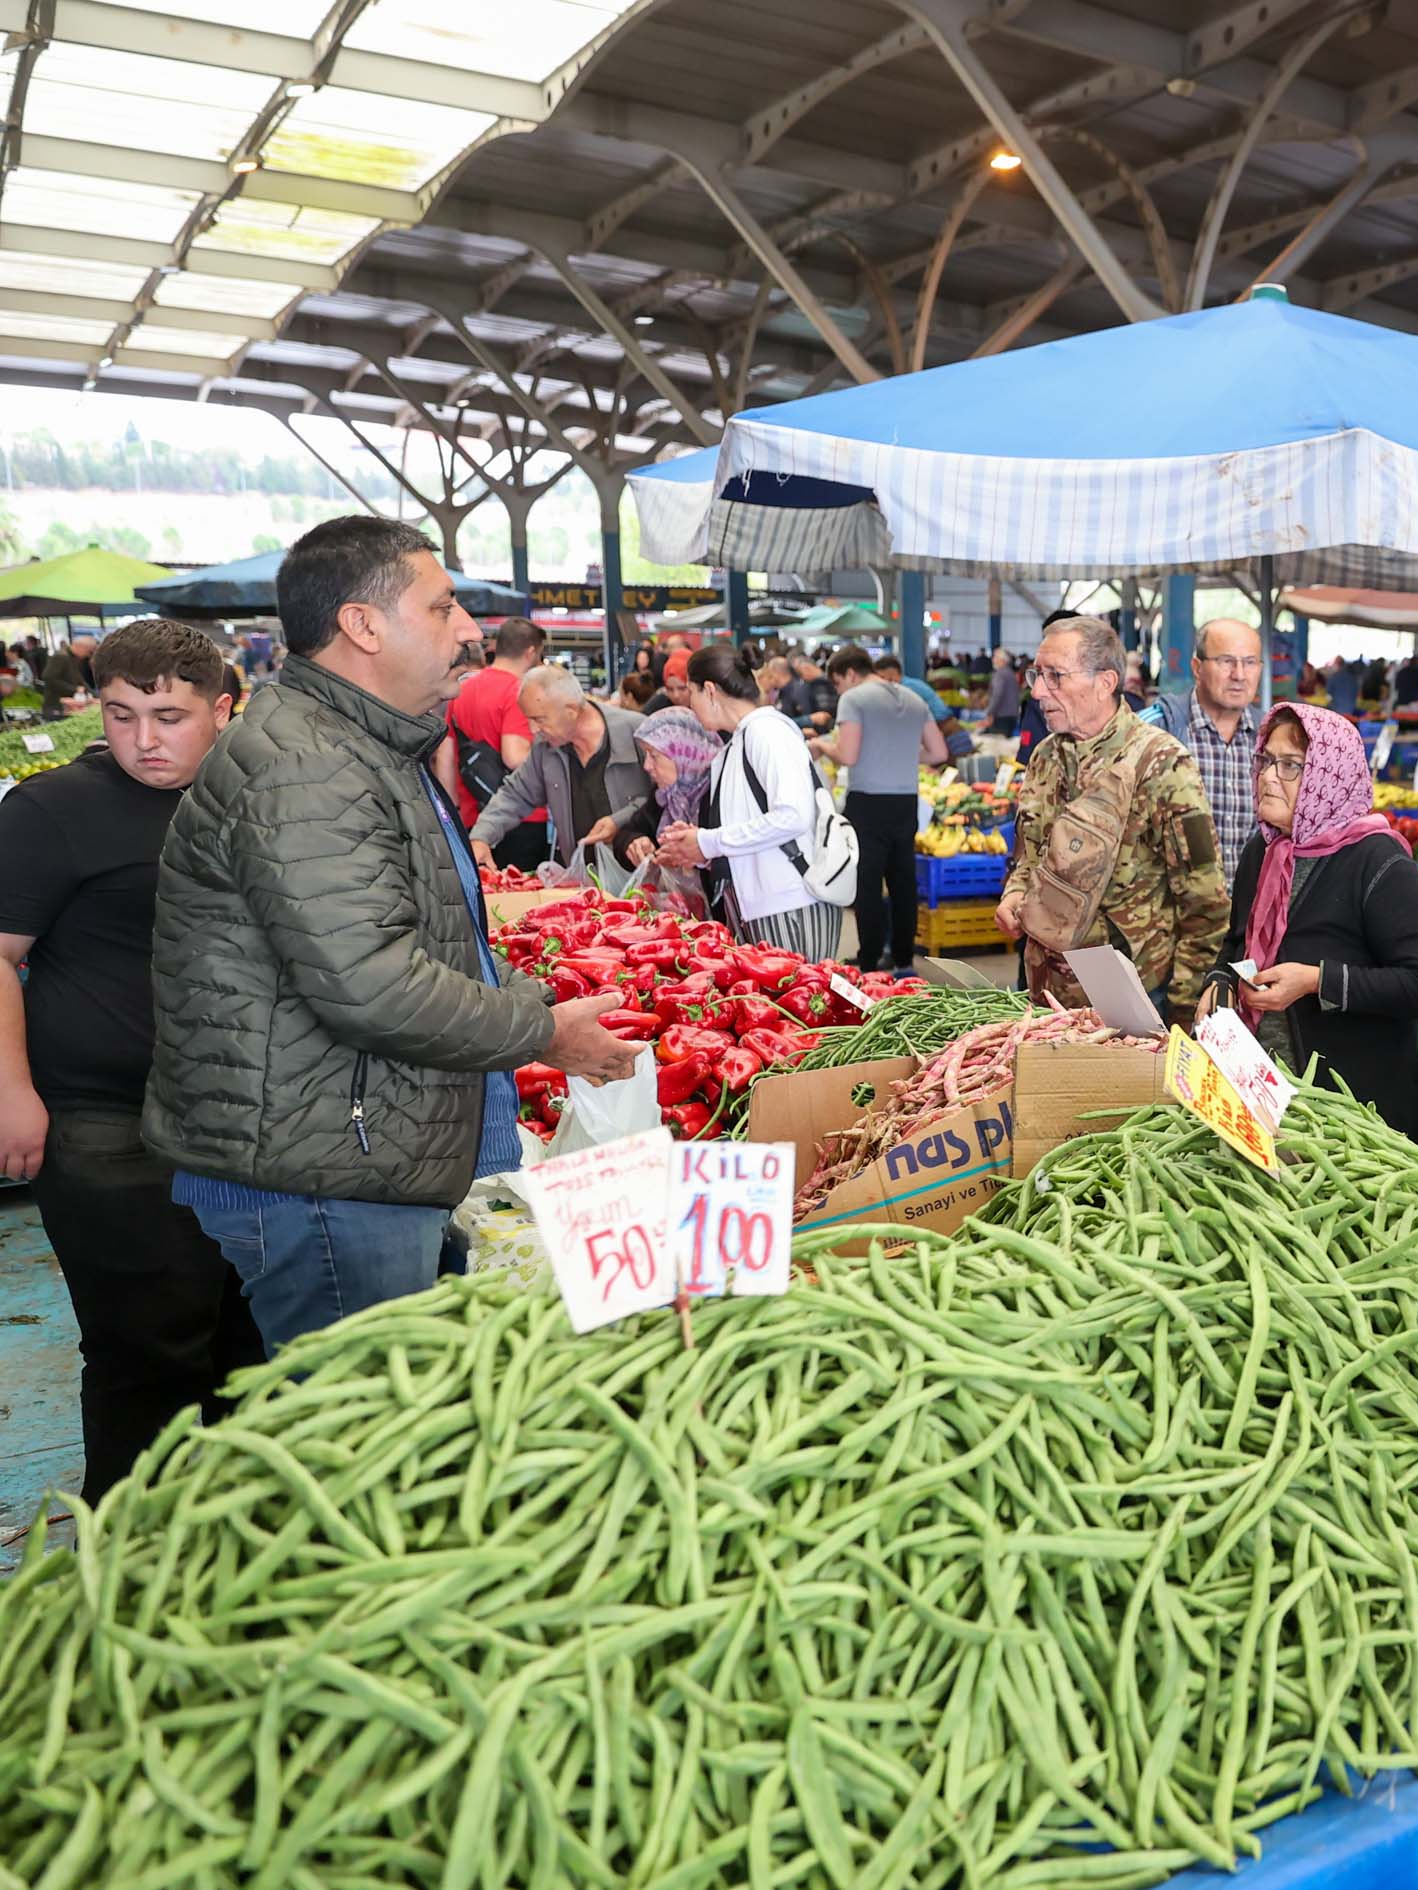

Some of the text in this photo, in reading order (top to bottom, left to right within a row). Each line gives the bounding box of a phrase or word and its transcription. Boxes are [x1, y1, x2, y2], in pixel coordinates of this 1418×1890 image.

[530, 589, 598, 606] HMET
[904, 1190, 956, 1221] Sanayi
[959, 1186, 976, 1200] ve
[585, 1224, 656, 1303] 50
[678, 1192, 773, 1293] 100
